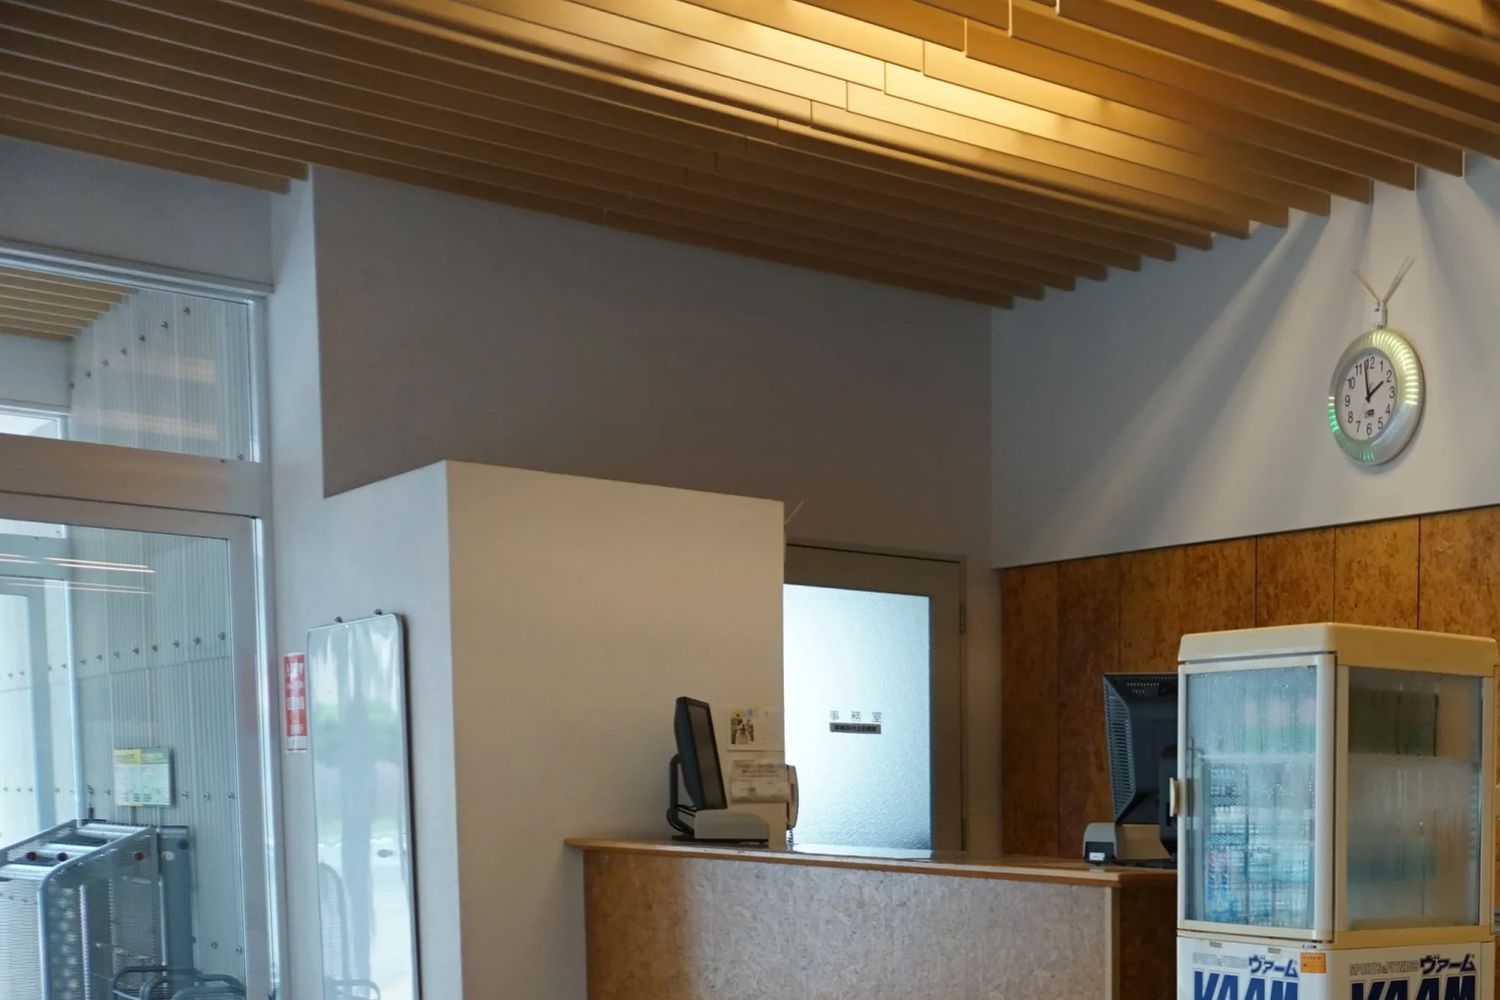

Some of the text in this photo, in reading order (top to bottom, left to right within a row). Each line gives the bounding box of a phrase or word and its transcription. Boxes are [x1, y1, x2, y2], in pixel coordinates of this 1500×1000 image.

[1355, 363, 1362, 376] 11
[1364, 356, 1375, 370] 12
[1379, 360, 1384, 372] 1
[1347, 376, 1355, 390] 10
[1386, 369, 1392, 383] 2
[1389, 385, 1396, 400] 3
[1345, 394, 1351, 408] 9
[1385, 403, 1391, 415] 4
[1347, 411, 1354, 424] 8
[1378, 416, 1384, 430] 5
[1356, 420, 1361, 433] 7
[1366, 422, 1372, 436] 6
[1248, 954, 1298, 978] ヴァーム
[1420, 953, 1476, 975] ヴァーム
